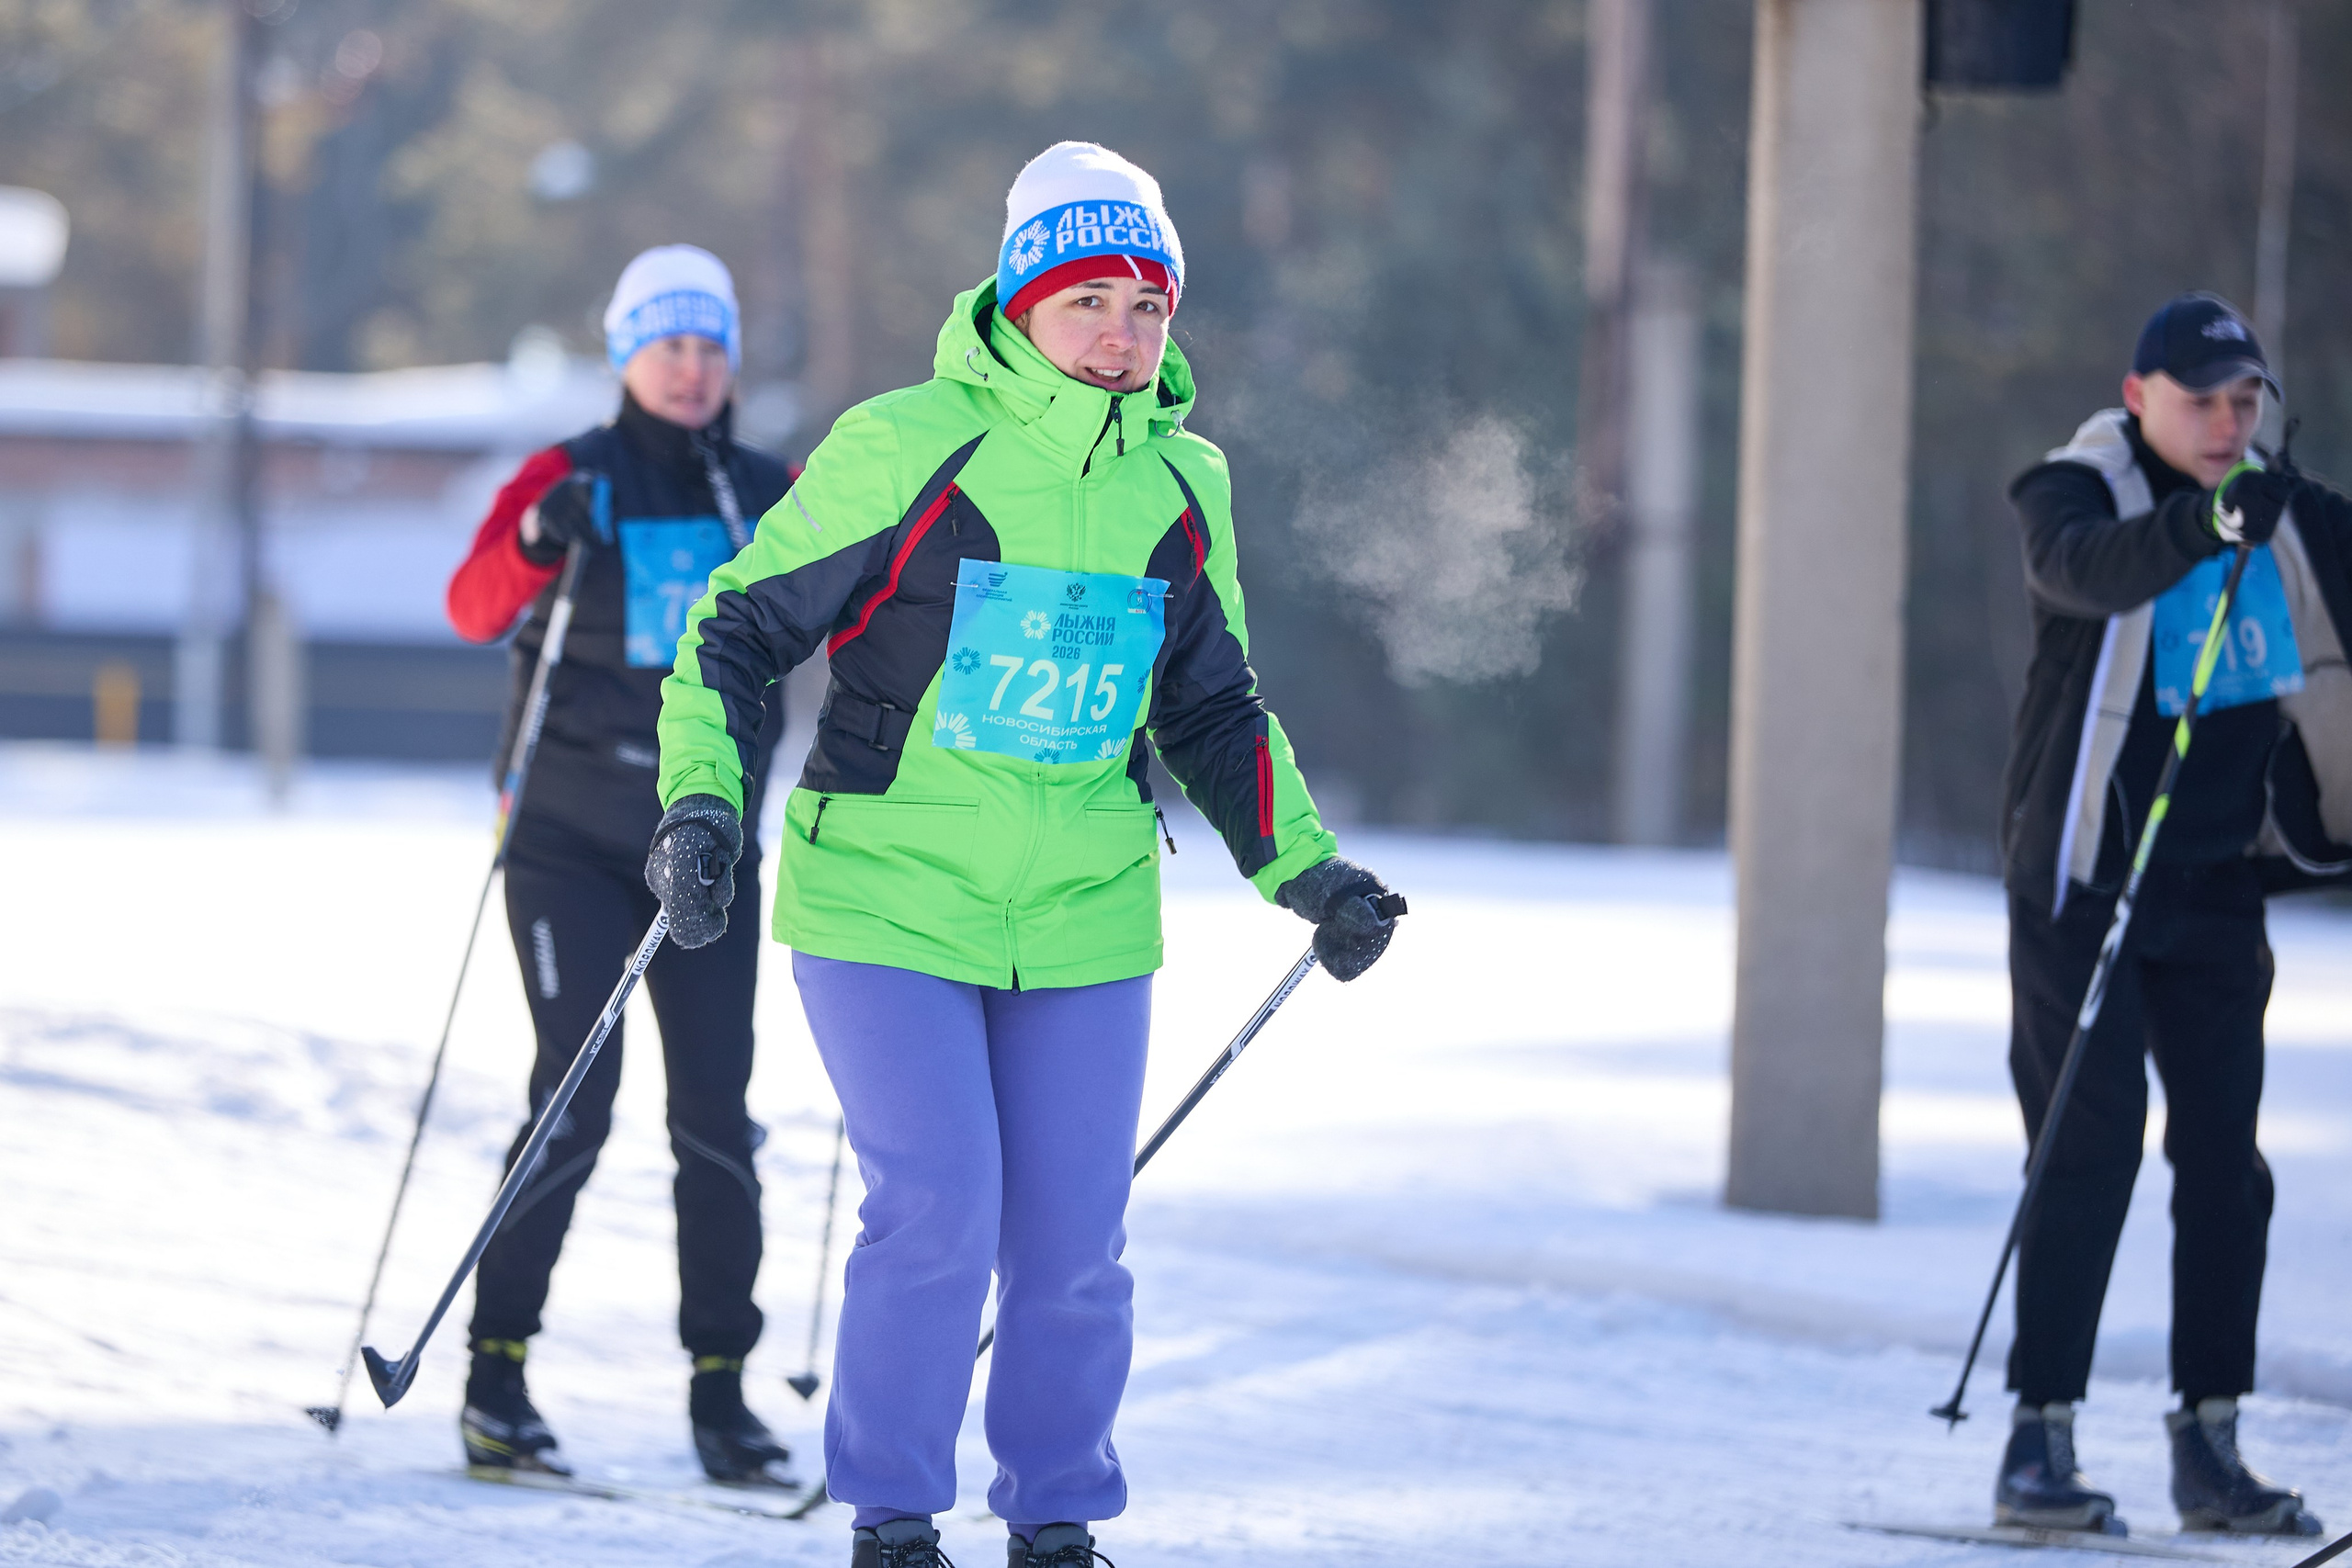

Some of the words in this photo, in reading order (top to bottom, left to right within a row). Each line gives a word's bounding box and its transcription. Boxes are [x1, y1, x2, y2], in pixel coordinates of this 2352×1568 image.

[1057, 226, 1170, 254] РОССИ
[1054, 613, 1116, 632] ЛЫЖНЯ
[1051, 627, 1114, 646] РОССИИ
[1051, 645, 1081, 660] 2026
[988, 654, 1125, 723] 7215
[981, 714, 1108, 738] НОВОСИБИРСКАЯ
[1019, 734, 1079, 751] ОБЛАСТЬ
[634, 929, 664, 974] NORDWAY
